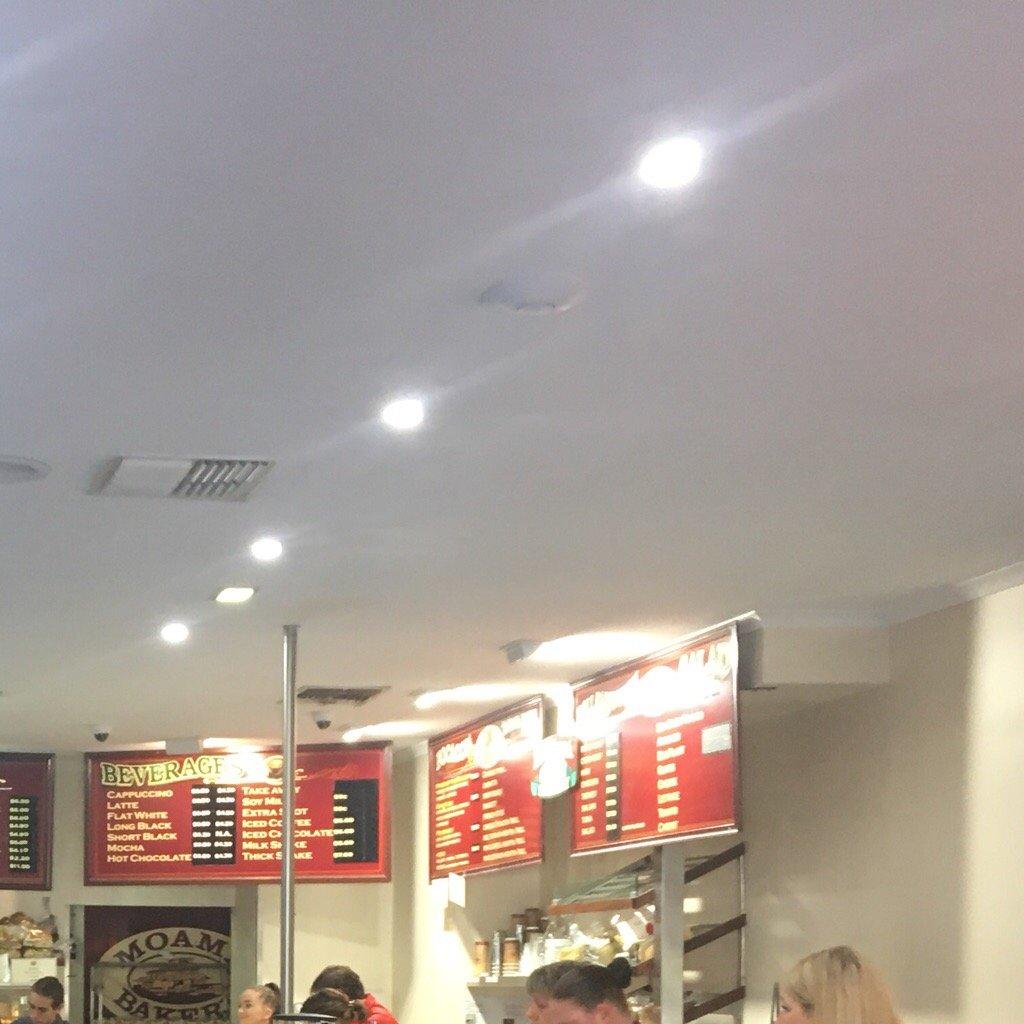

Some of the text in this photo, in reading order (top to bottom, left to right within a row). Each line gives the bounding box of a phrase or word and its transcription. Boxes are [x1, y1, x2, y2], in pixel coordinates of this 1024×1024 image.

[106, 790, 173, 799] CAPPUCCINO
[242, 786, 301, 795] TAKE AY
[242, 797, 283, 806] SOY MIL
[107, 811, 168, 820] FLAT WHITE
[242, 808, 309, 817] EXTRA SOT
[107, 822, 172, 831] LONG BLACK
[242, 818, 312, 828] ICED COEE
[107, 833, 177, 842] SHORT BLACK
[242, 829, 334, 839] ICED CHCOLATE
[107, 844, 145, 852] MOCHA
[242, 840, 308, 850] MILK SHKE
[107, 854, 192, 863] HOT CHOCOLATE
[242, 852, 313, 861] THICK SAKE
[113, 929, 230, 969] MOAM
[113, 986, 228, 1019] BAKER
